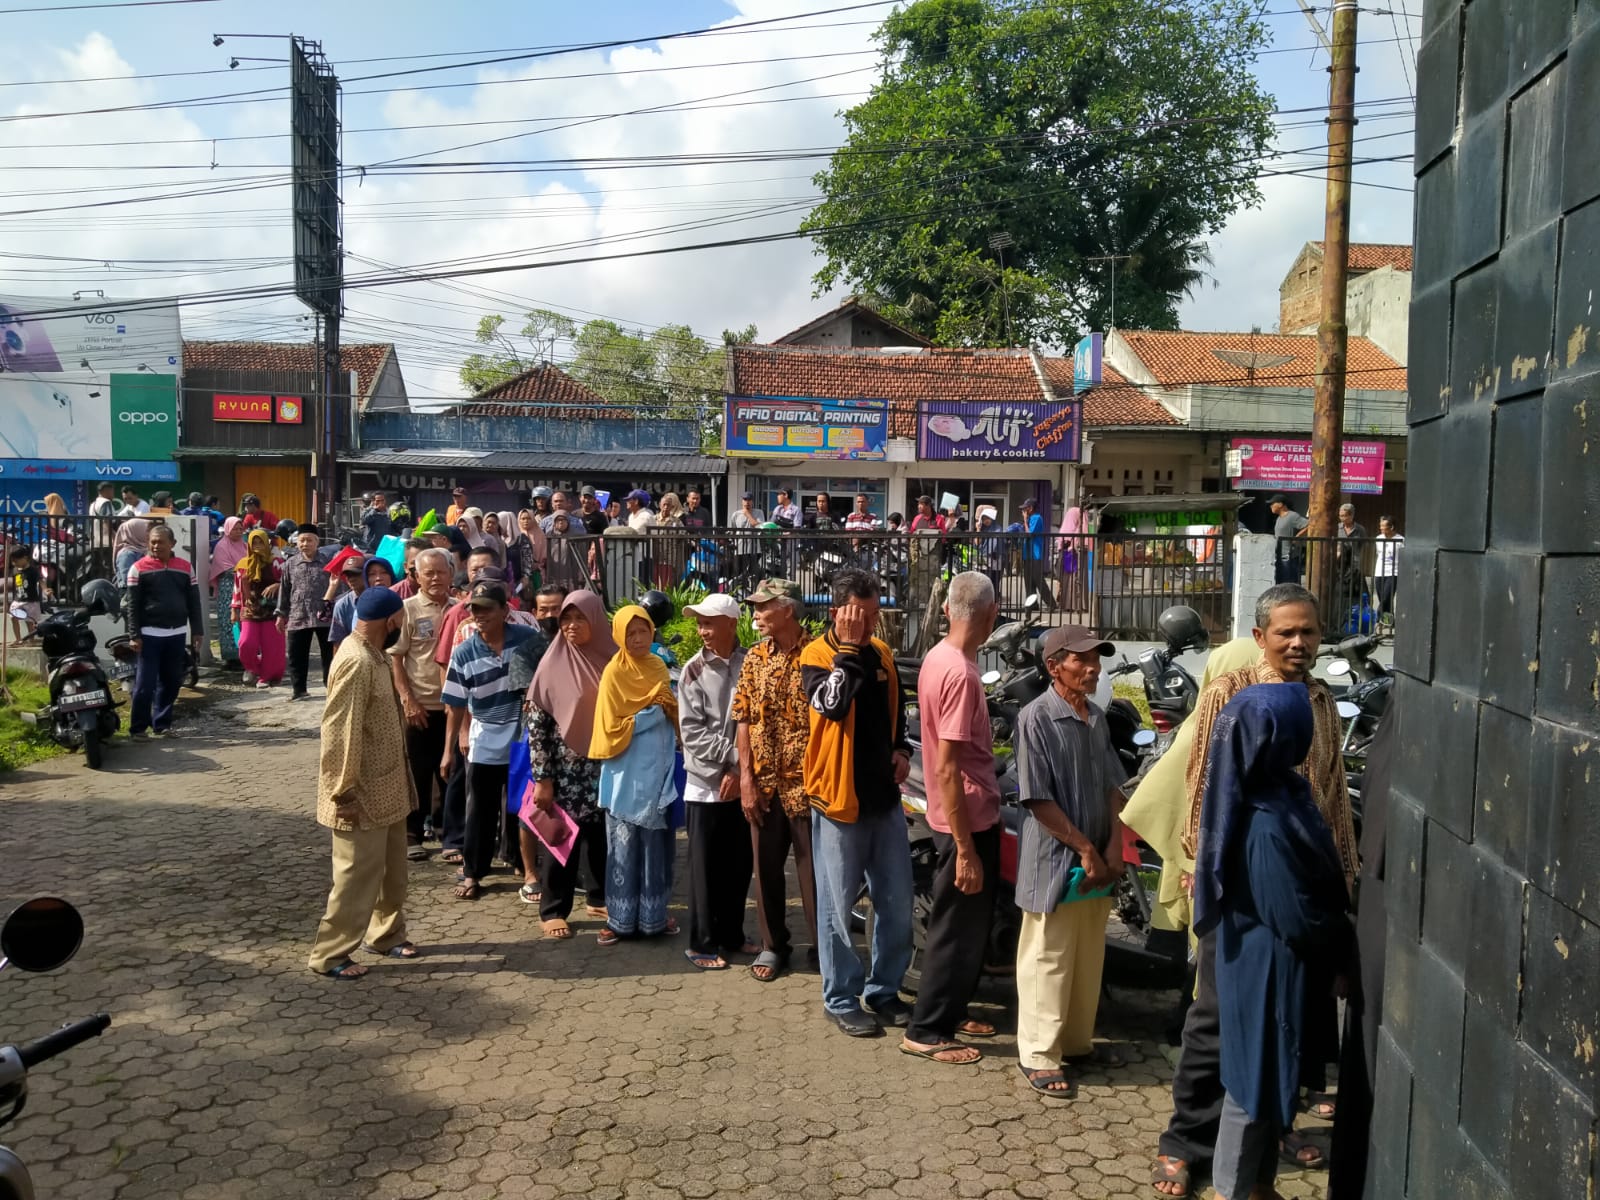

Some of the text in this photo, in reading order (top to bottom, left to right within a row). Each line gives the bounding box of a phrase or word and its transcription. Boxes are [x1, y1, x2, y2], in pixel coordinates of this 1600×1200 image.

[219, 401, 270, 411] RYUNA
[118, 411, 168, 425] oppo
[737, 408, 880, 423] FIFID DIGITAL PRINTING
[972, 406, 1033, 447] Alif's
[952, 448, 1046, 459] bakery & cookies
[1262, 444, 1305, 453] PRAKTEK
[1348, 446, 1377, 454] UMUM
[1274, 454, 1286, 462] dr.
[95, 464, 133, 476] vivo
[0, 494, 48, 512] ivo
